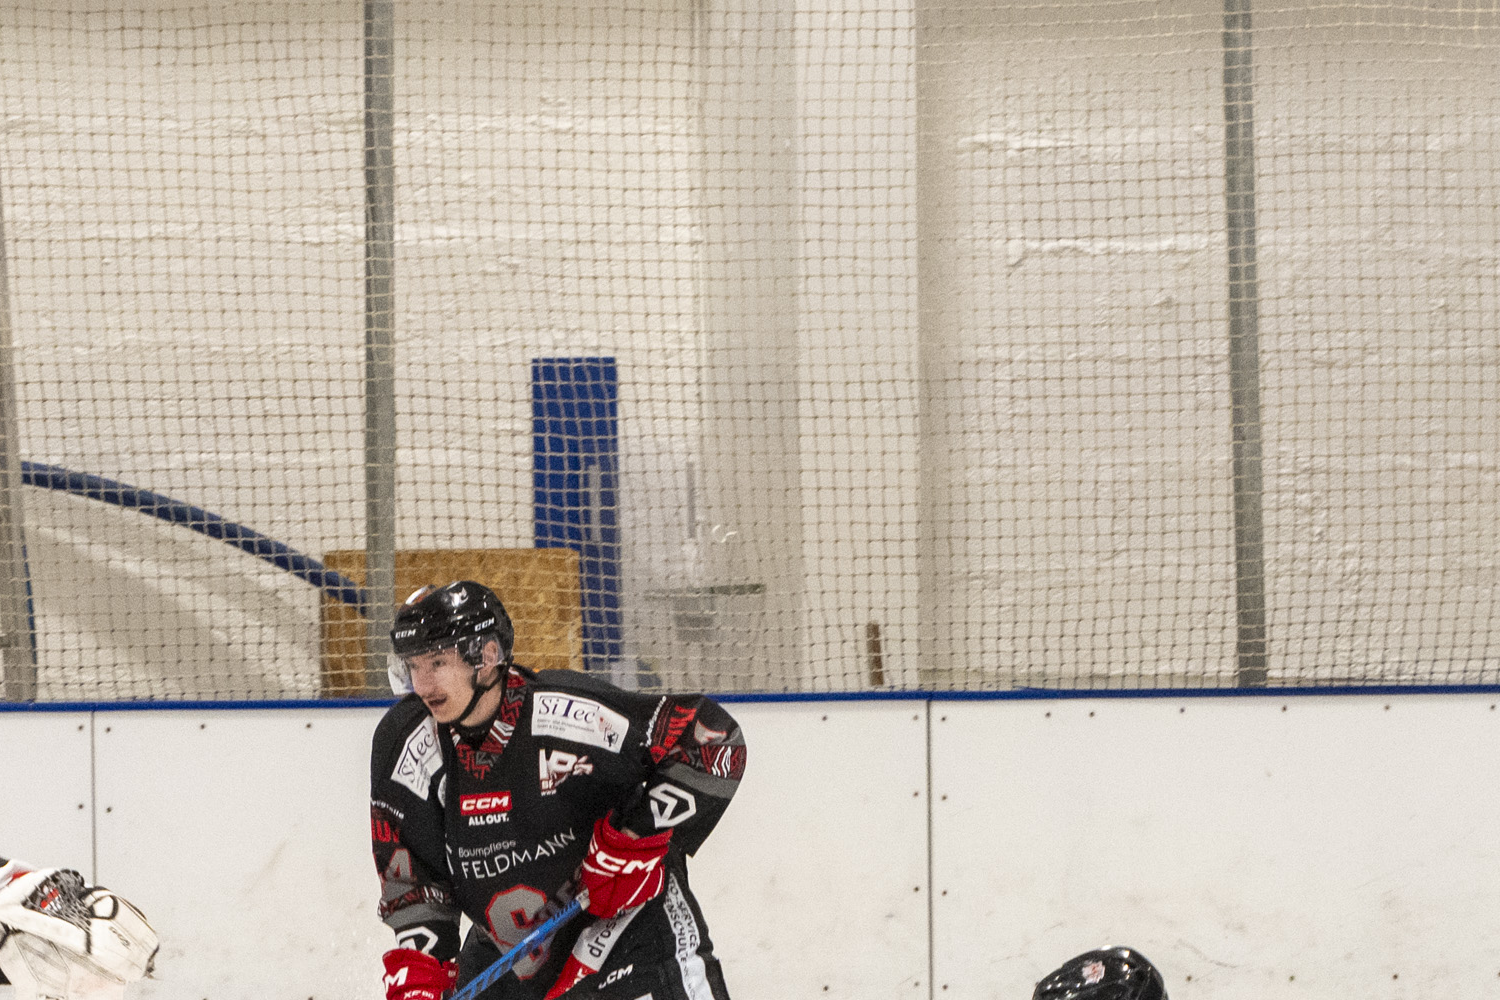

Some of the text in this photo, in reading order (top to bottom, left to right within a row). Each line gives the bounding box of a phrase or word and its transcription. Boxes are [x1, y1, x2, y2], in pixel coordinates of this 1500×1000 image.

[474, 617, 495, 632] CCM
[395, 628, 417, 639] CCM
[538, 694, 600, 724] SiTec
[462, 795, 509, 811] CCM
[468, 812, 510, 827] ALL OUT.
[458, 839, 517, 858] Baumpflege
[461, 827, 576, 879] FELDMANN
